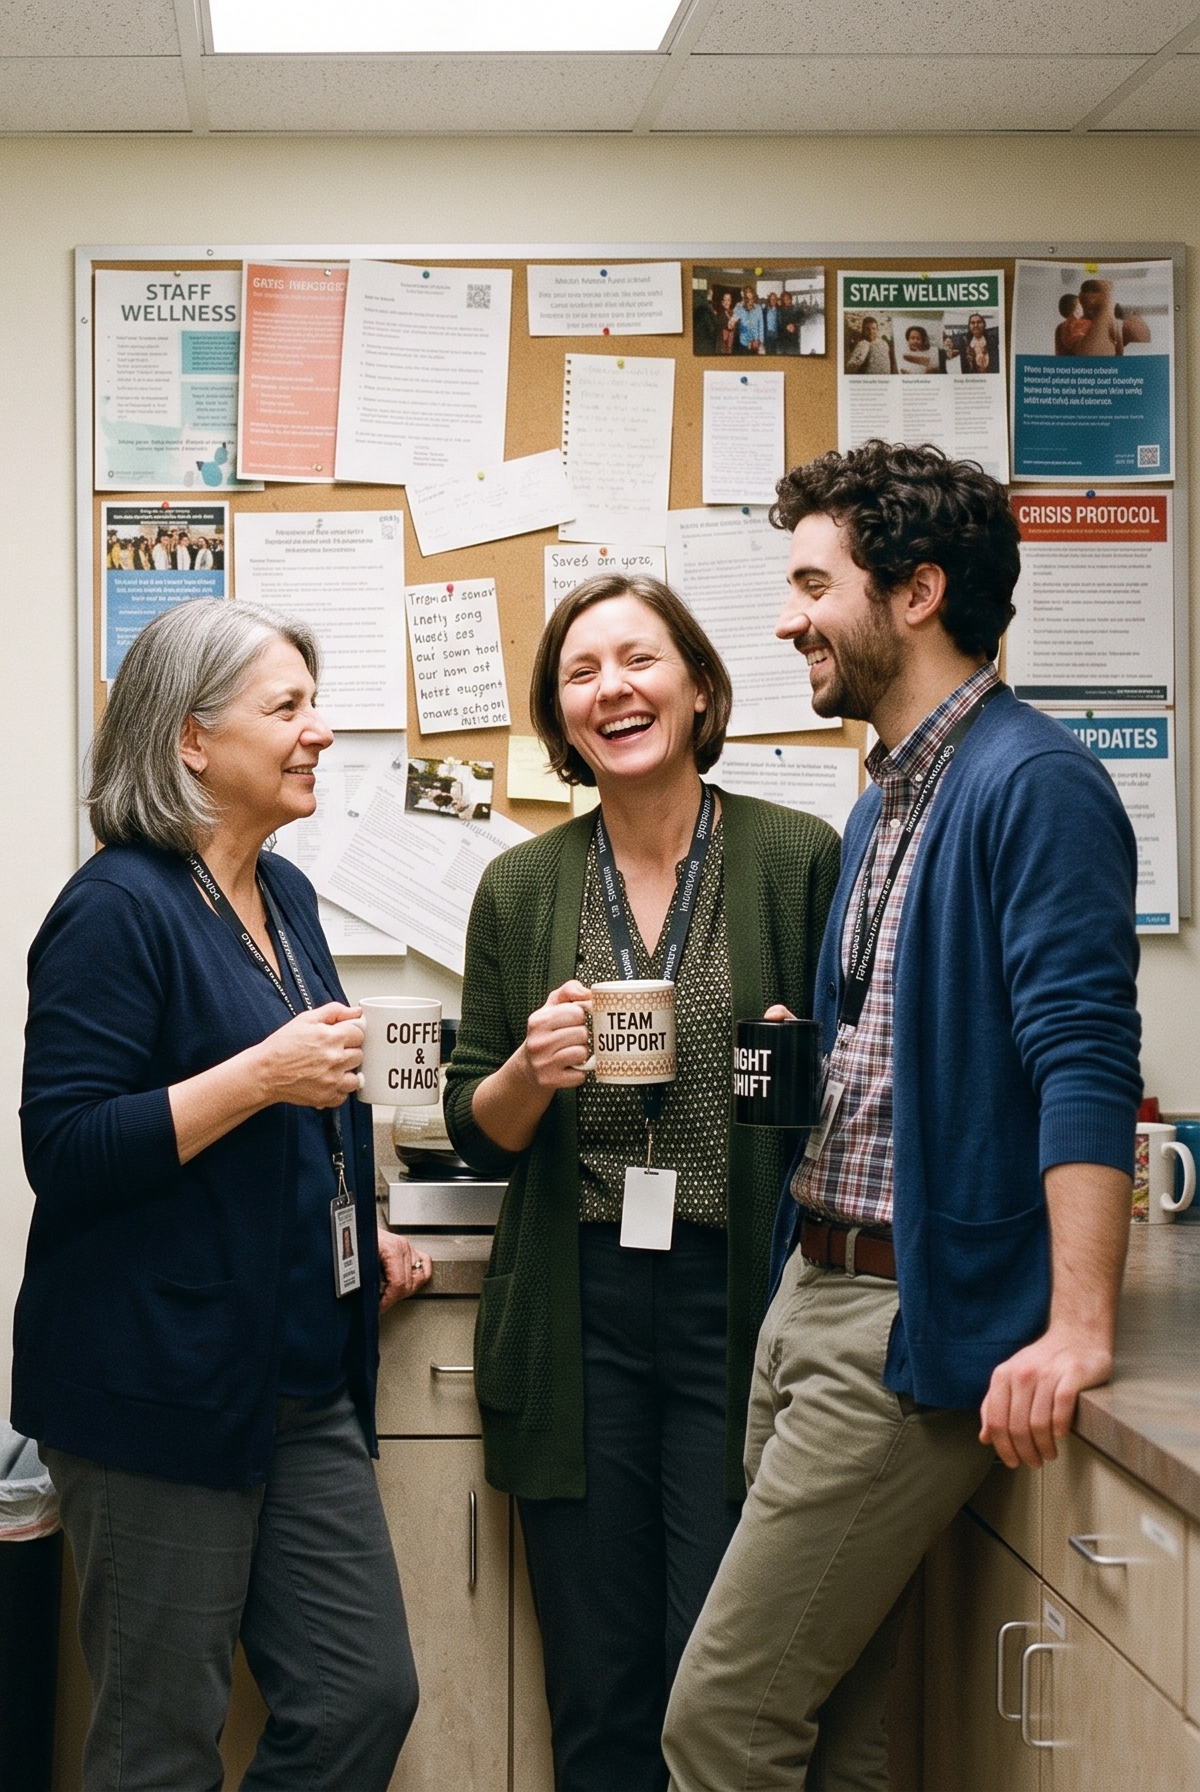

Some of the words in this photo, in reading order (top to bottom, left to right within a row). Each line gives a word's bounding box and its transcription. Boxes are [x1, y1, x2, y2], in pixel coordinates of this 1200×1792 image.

[146, 284, 212, 301] STAFF
[850, 283, 899, 302] STAFF
[903, 283, 990, 301] WELLNESS
[121, 304, 237, 322] WELLNESS
[1019, 506, 1072, 524] CRISIS
[1076, 505, 1160, 524] PROTOCOL
[455, 610, 483, 623] song
[607, 1012, 653, 1030] TEAM
[598, 1032, 667, 1052] SUPPORT
[415, 1048, 425, 1064] &
[388, 1068, 439, 1090] CHAOS
